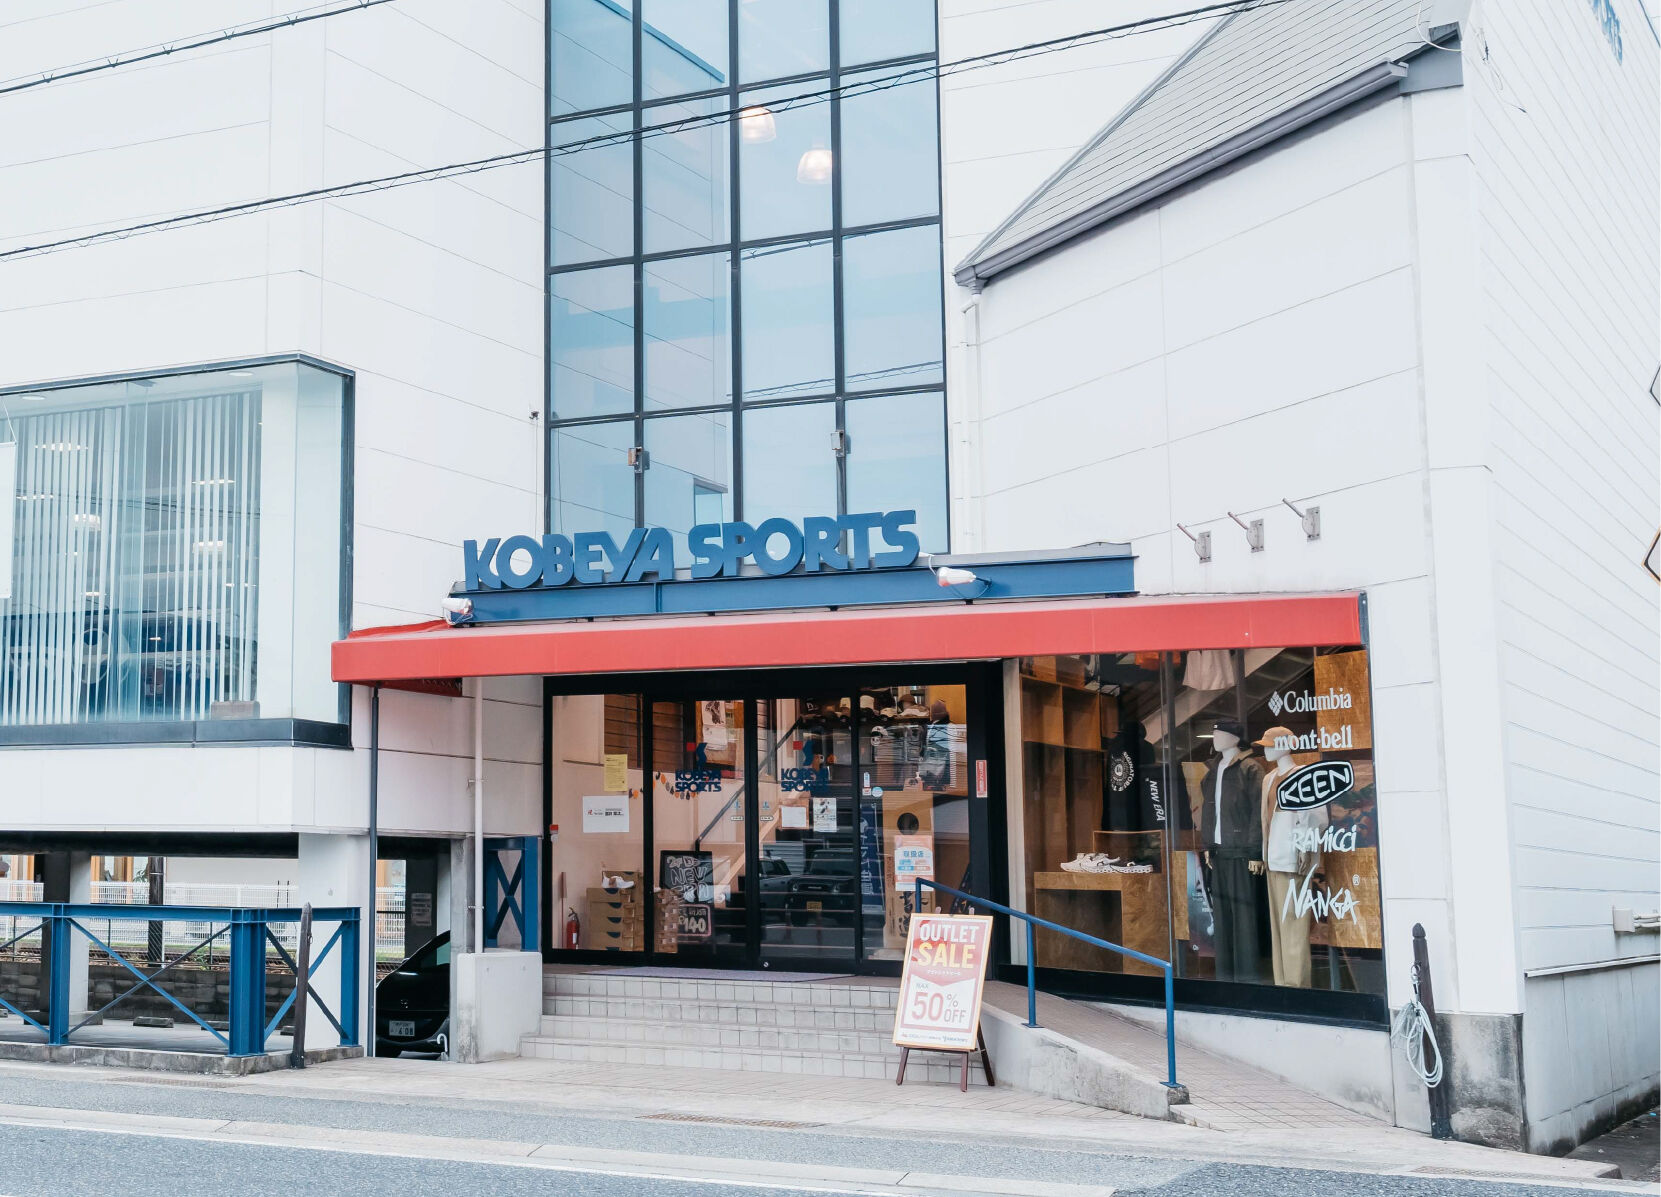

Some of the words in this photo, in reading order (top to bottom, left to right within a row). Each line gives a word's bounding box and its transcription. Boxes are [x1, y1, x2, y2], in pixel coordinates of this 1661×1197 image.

[464, 527, 675, 591] KOBEYA
[688, 510, 920, 578] SPORTS
[1283, 687, 1352, 713] Columbia
[1149, 780, 1161, 803] NEW
[1280, 767, 1350, 804] KEEN
[1153, 803, 1166, 821] ERA
[920, 923, 979, 943] OUTLET
[917, 942, 975, 969] SALE
[911, 993, 944, 1022] 50
[944, 1009, 966, 1023] OFF
